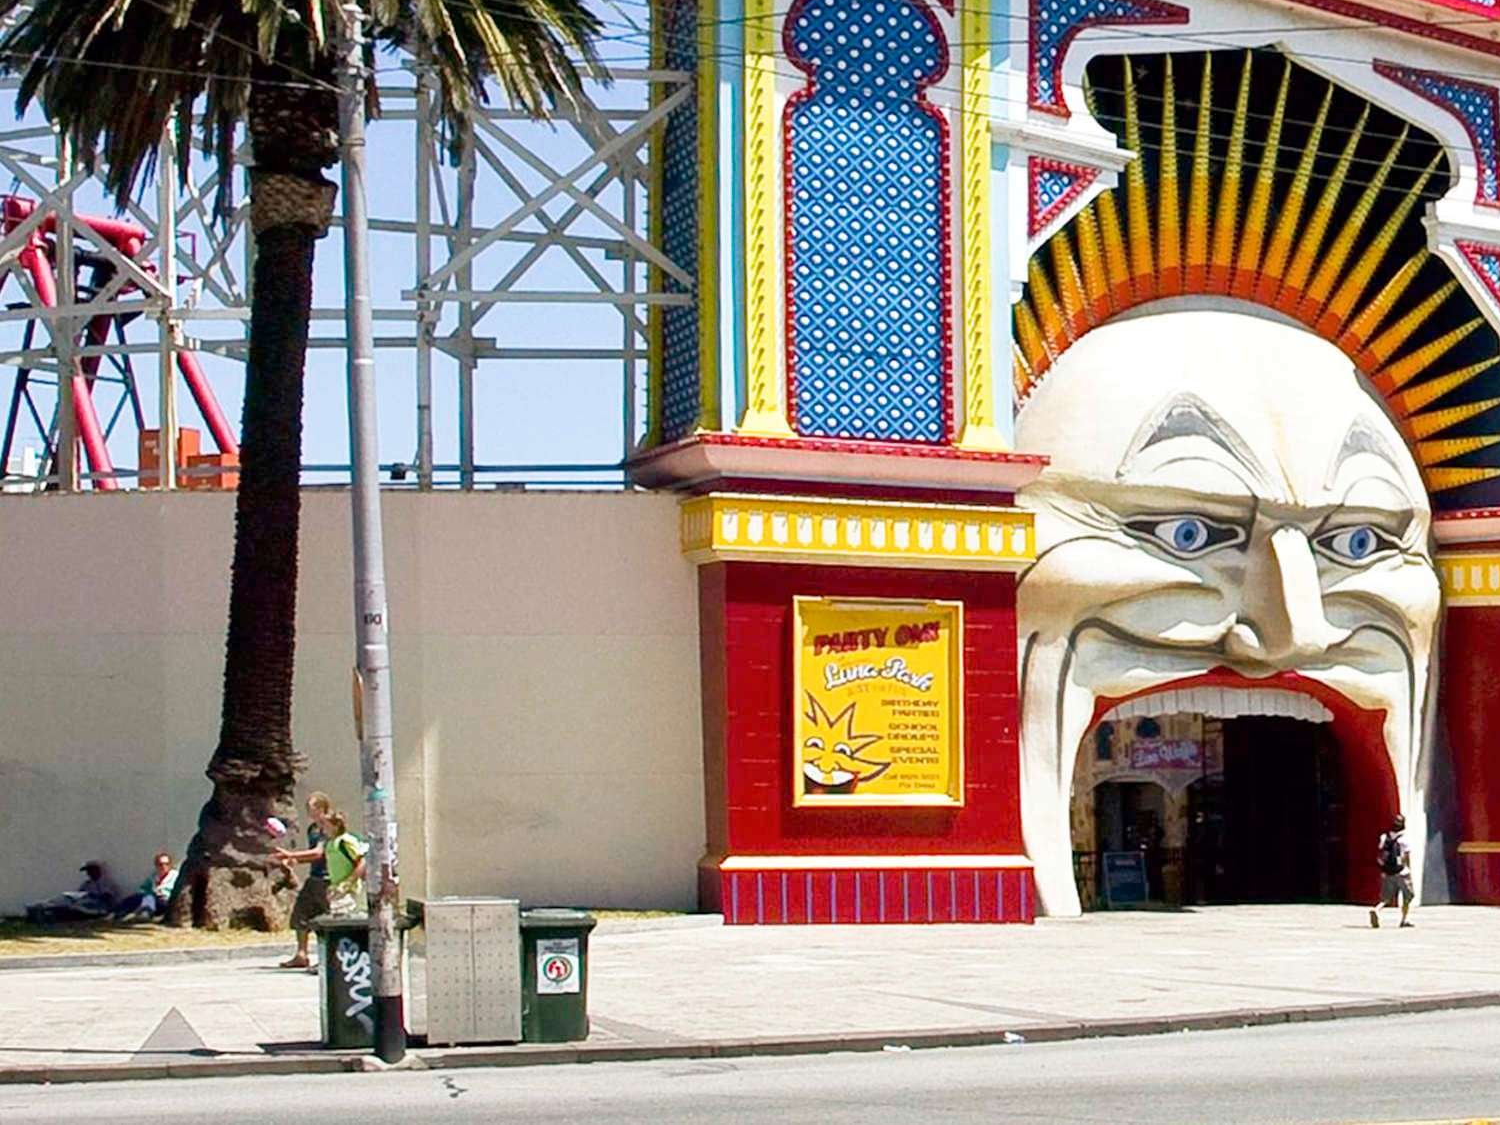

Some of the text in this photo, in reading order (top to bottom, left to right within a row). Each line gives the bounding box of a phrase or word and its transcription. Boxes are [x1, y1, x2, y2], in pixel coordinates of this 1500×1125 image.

[813, 627, 889, 656] PARTY
[890, 746, 939, 755] SPECIAL
[892, 756, 940, 765] EVENTS
